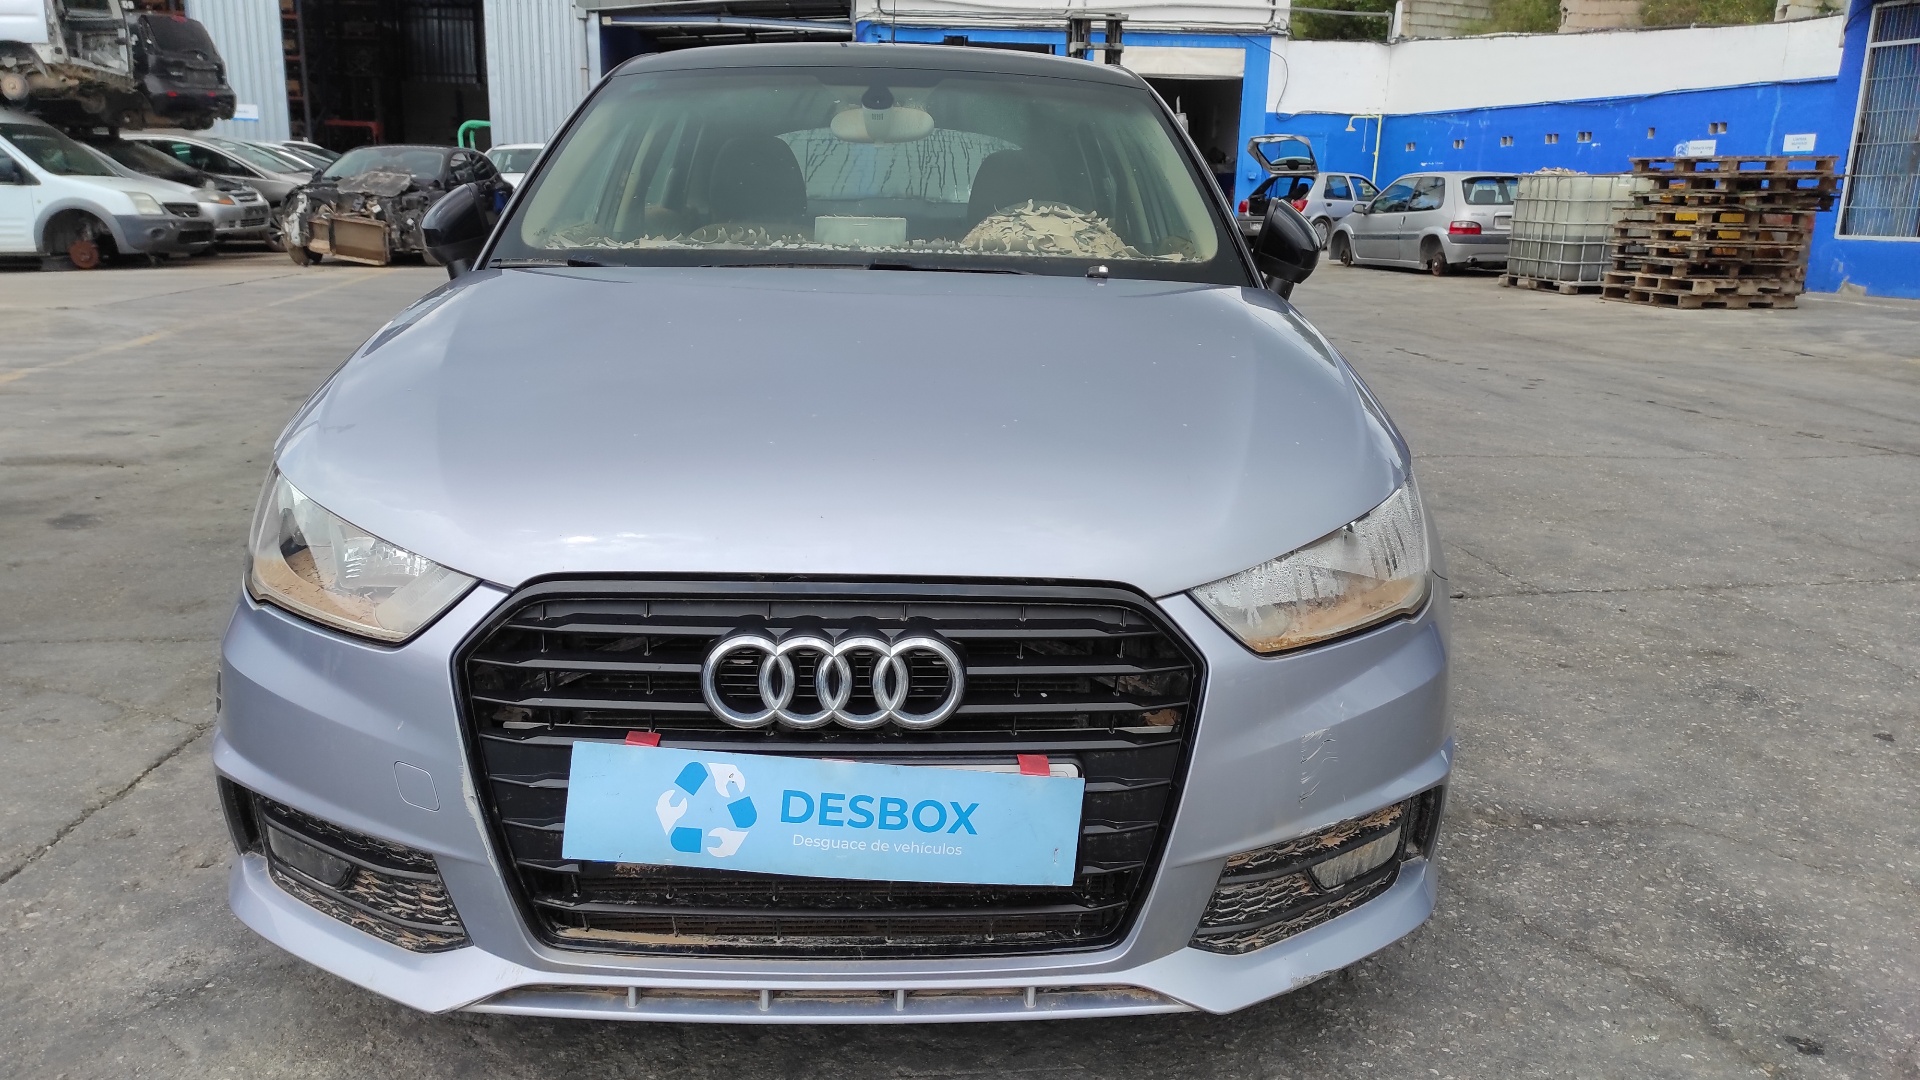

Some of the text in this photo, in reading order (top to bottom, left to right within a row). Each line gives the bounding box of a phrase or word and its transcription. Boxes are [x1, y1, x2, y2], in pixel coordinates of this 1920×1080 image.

[781, 790, 979, 835] DESBOX
[792, 834, 962, 856] Desguace de vehículos
